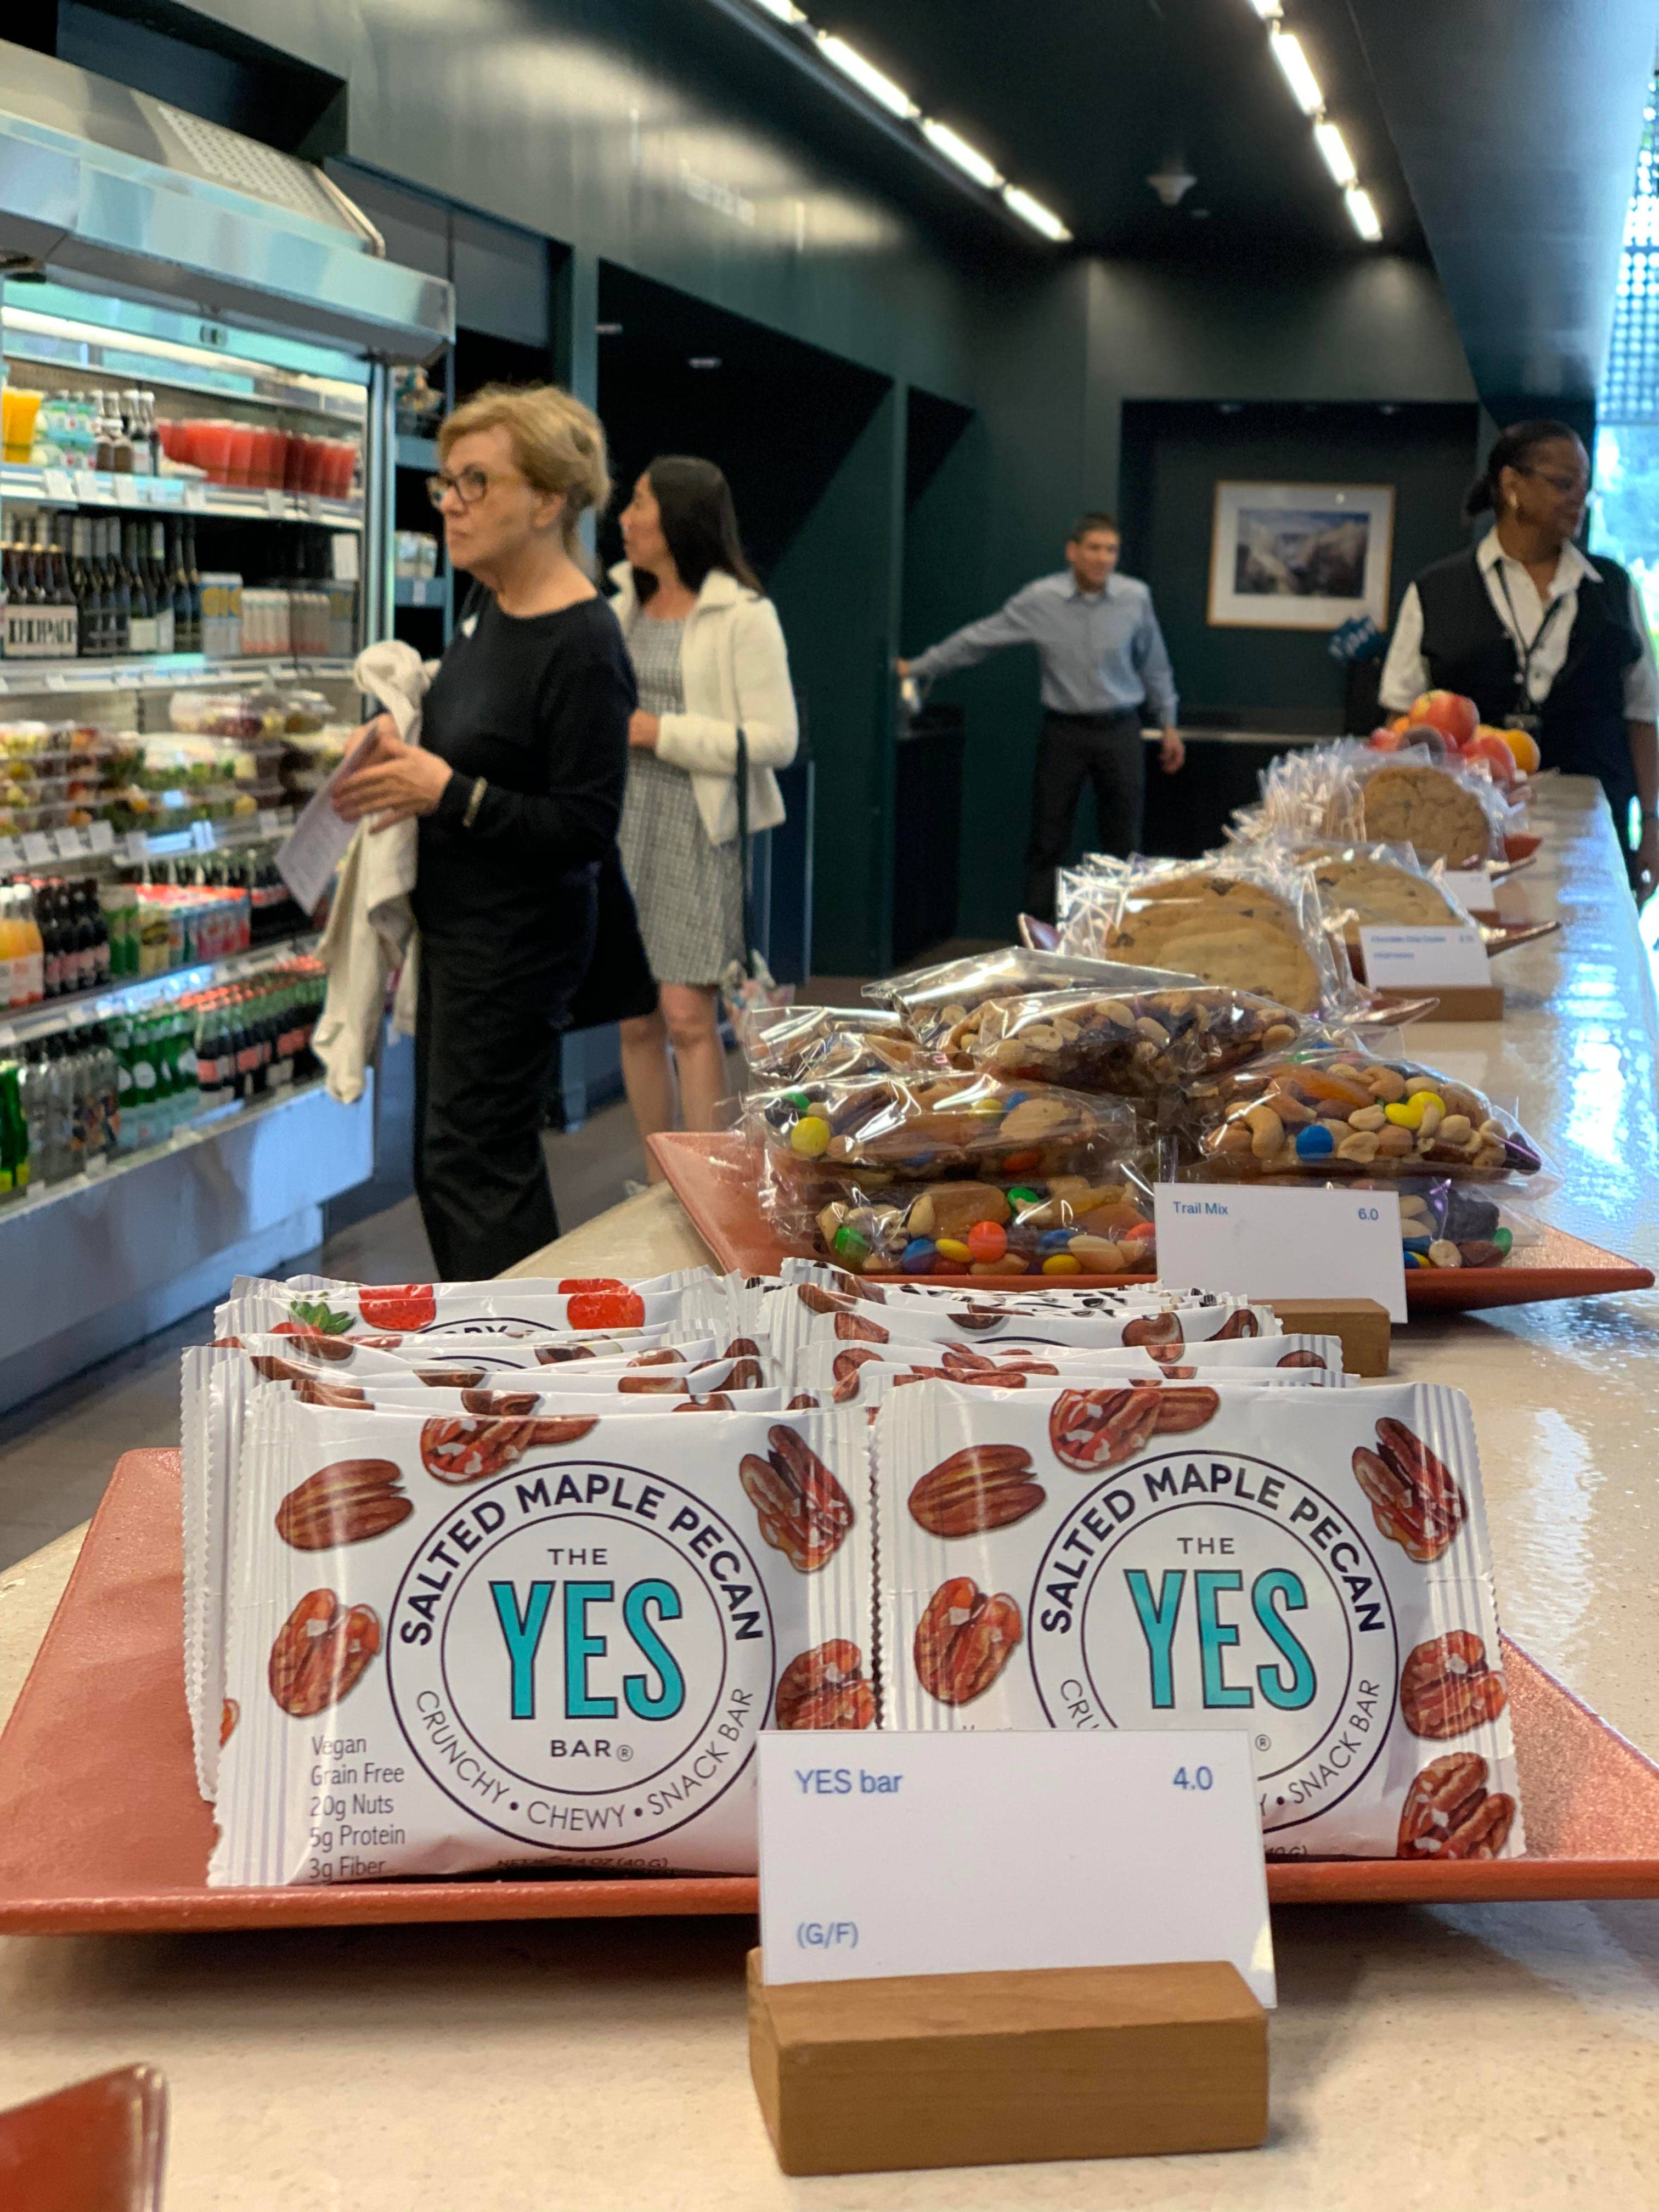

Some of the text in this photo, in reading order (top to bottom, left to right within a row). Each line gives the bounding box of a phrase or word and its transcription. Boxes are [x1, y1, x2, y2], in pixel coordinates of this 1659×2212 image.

[1173, 1201, 1228, 1215] Trail Mix
[1358, 1208, 1378, 1220] 6.0
[548, 1549, 608, 1565] THE
[1041, 1463, 1385, 1634] SALTED MAPLE PECAN
[1177, 1538, 1234, 1554] THE
[400, 1474, 764, 1646] SALTED MAPLE PECAN
[488, 1578, 686, 1721] YES
[1123, 1567, 1318, 1711] YES
[312, 1735, 366, 1760] Vegan
[1289, 1680, 1380, 1804] SNACK BAR
[417, 1689, 753, 1831] CRUNCHY CHEWY SNACK BAR
[311, 1763, 404, 1785] Grain Free
[795, 1769, 902, 1793] YES bar
[1173, 1766, 1213, 1790] 4.0
[310, 1793, 394, 1820] 20g Nuts
[310, 1824, 405, 1853] 5g Protein
[309, 1855, 386, 1883] 3g Fiber
[797, 1922, 859, 1949] (G/F)
